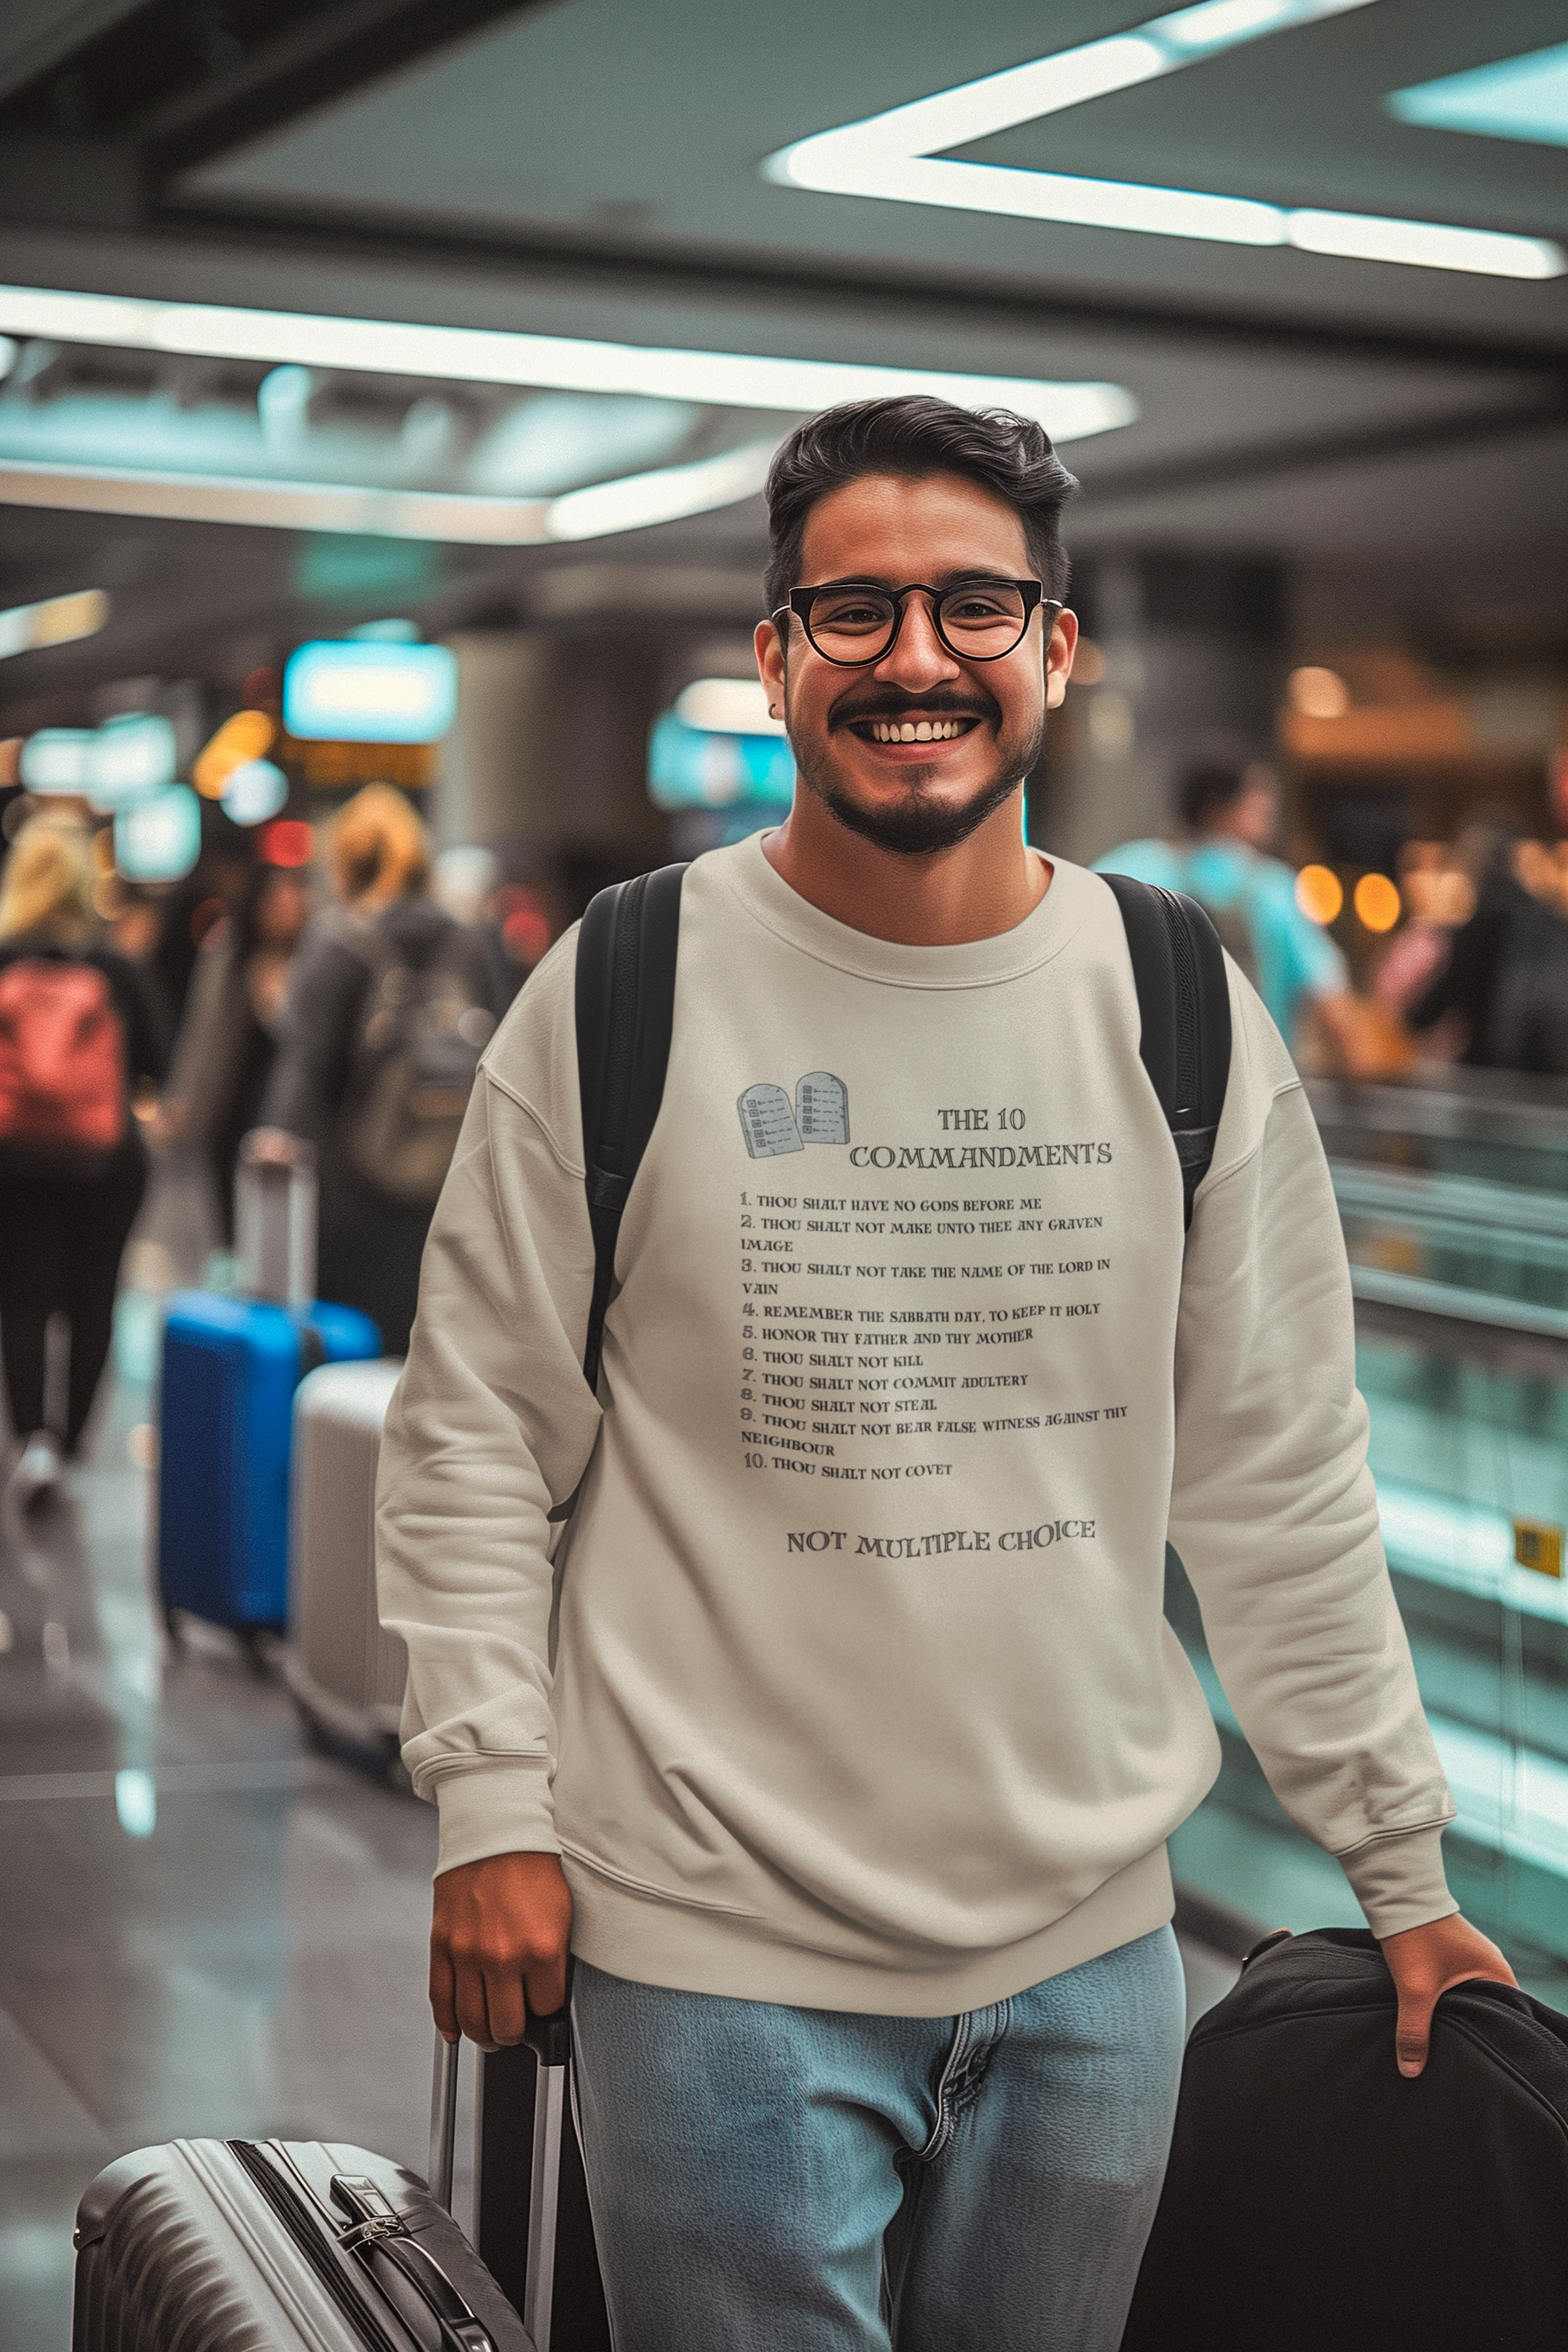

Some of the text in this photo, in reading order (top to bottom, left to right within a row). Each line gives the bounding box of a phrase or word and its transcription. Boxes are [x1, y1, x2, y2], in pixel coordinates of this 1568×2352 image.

[937, 1107, 1026, 1131] THE 10
[849, 1142, 1112, 1169] COMMANDMENTS
[740, 1192, 1042, 1212] 1. THOU SHALT HAVE NO GODS BEFORE ME
[740, 1214, 1103, 1235] 2. THOU SHALT NOT MAKE UNTO THEE ANY GRAVEN
[741, 1238, 793, 1252] IMAGE
[741, 1258, 1110, 1279] 3. THOU SHALT NOT TAKE THE NAME OF THE LORD IN
[742, 1283, 779, 1295] VAIN
[742, 1302, 1101, 1323] 4. REMEMBER THE SABBATH DAY, TO KEEP IT HOLY
[742, 1325, 1033, 1345] 5. HONOR THY FATHER AND THY MOTHER
[742, 1347, 924, 1368] 6. THOU SHALT NOT KILL
[742, 1368, 1029, 1391] 7. THOU SHALT NOT COMMIT ADULTERY
[741, 1388, 938, 1414] 8. THOU SHALT NOT STEAL
[740, 1406, 1127, 1436] 9. THOU SHALT NOT BEAR FALSE WITNESS AGAINST THY
[741, 1431, 835, 1457] NEIGHBOUR
[744, 1452, 953, 1480] 10. THOU SHALT NOT COVET
[786, 1520, 1095, 1559] NOT MULTIPLE CHOICE
